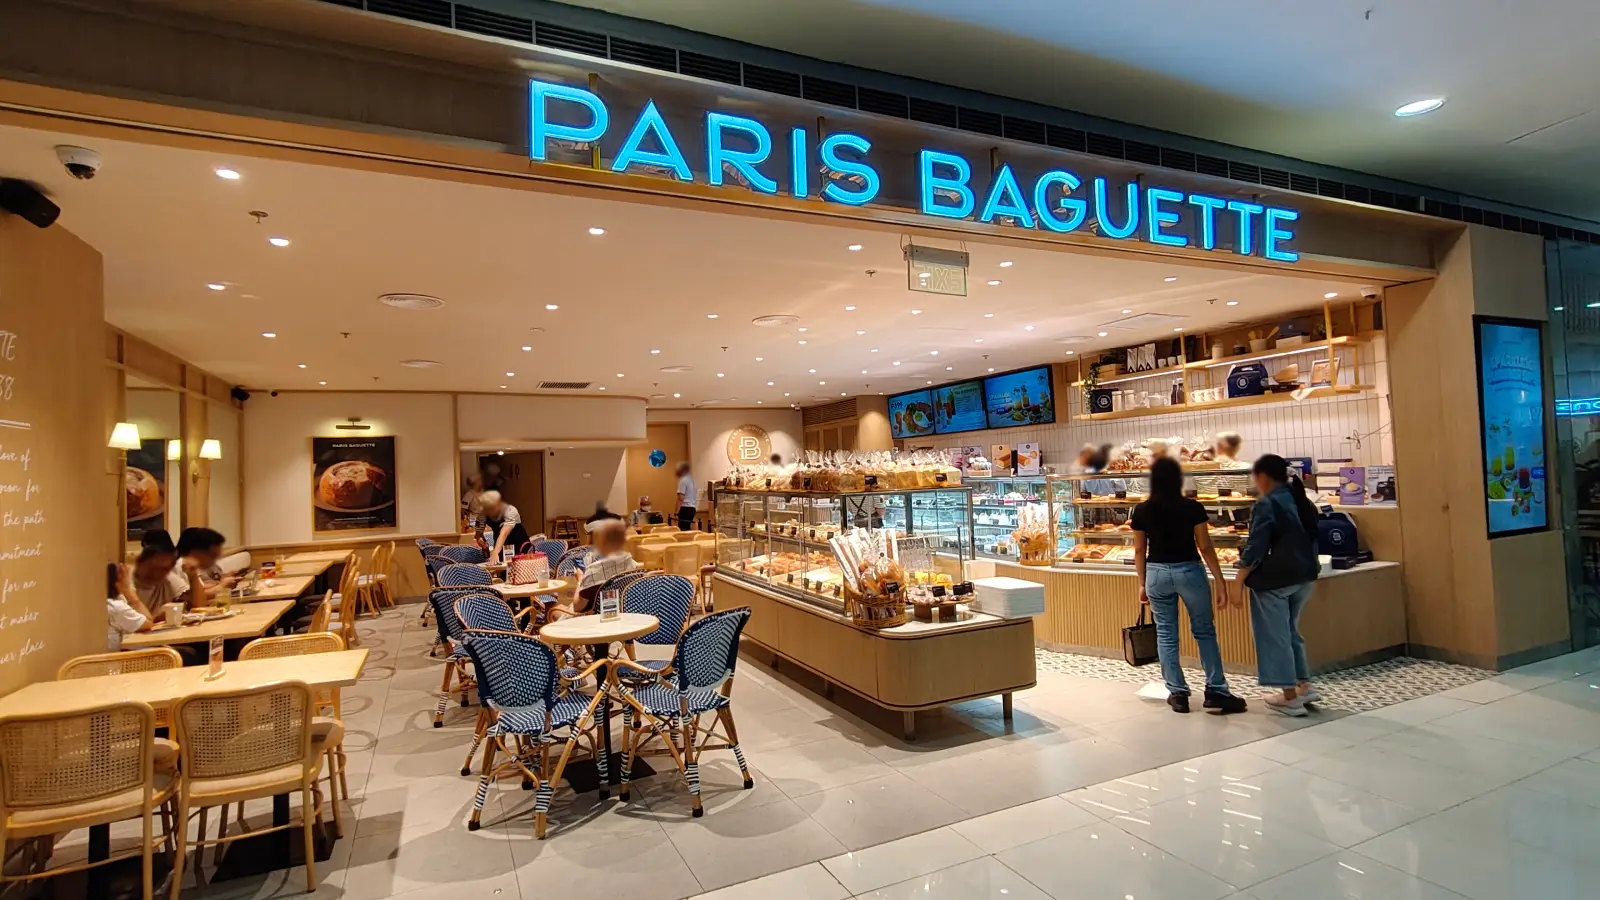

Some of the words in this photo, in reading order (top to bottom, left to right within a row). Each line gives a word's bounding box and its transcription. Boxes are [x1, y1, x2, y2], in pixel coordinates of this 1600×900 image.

[529, 78, 880, 205] PARIS
[920, 149, 1299, 262] BAGUETTE
[20, 448, 31, 471] of
[4, 509, 20, 526] the
[2, 578, 19, 603] for
